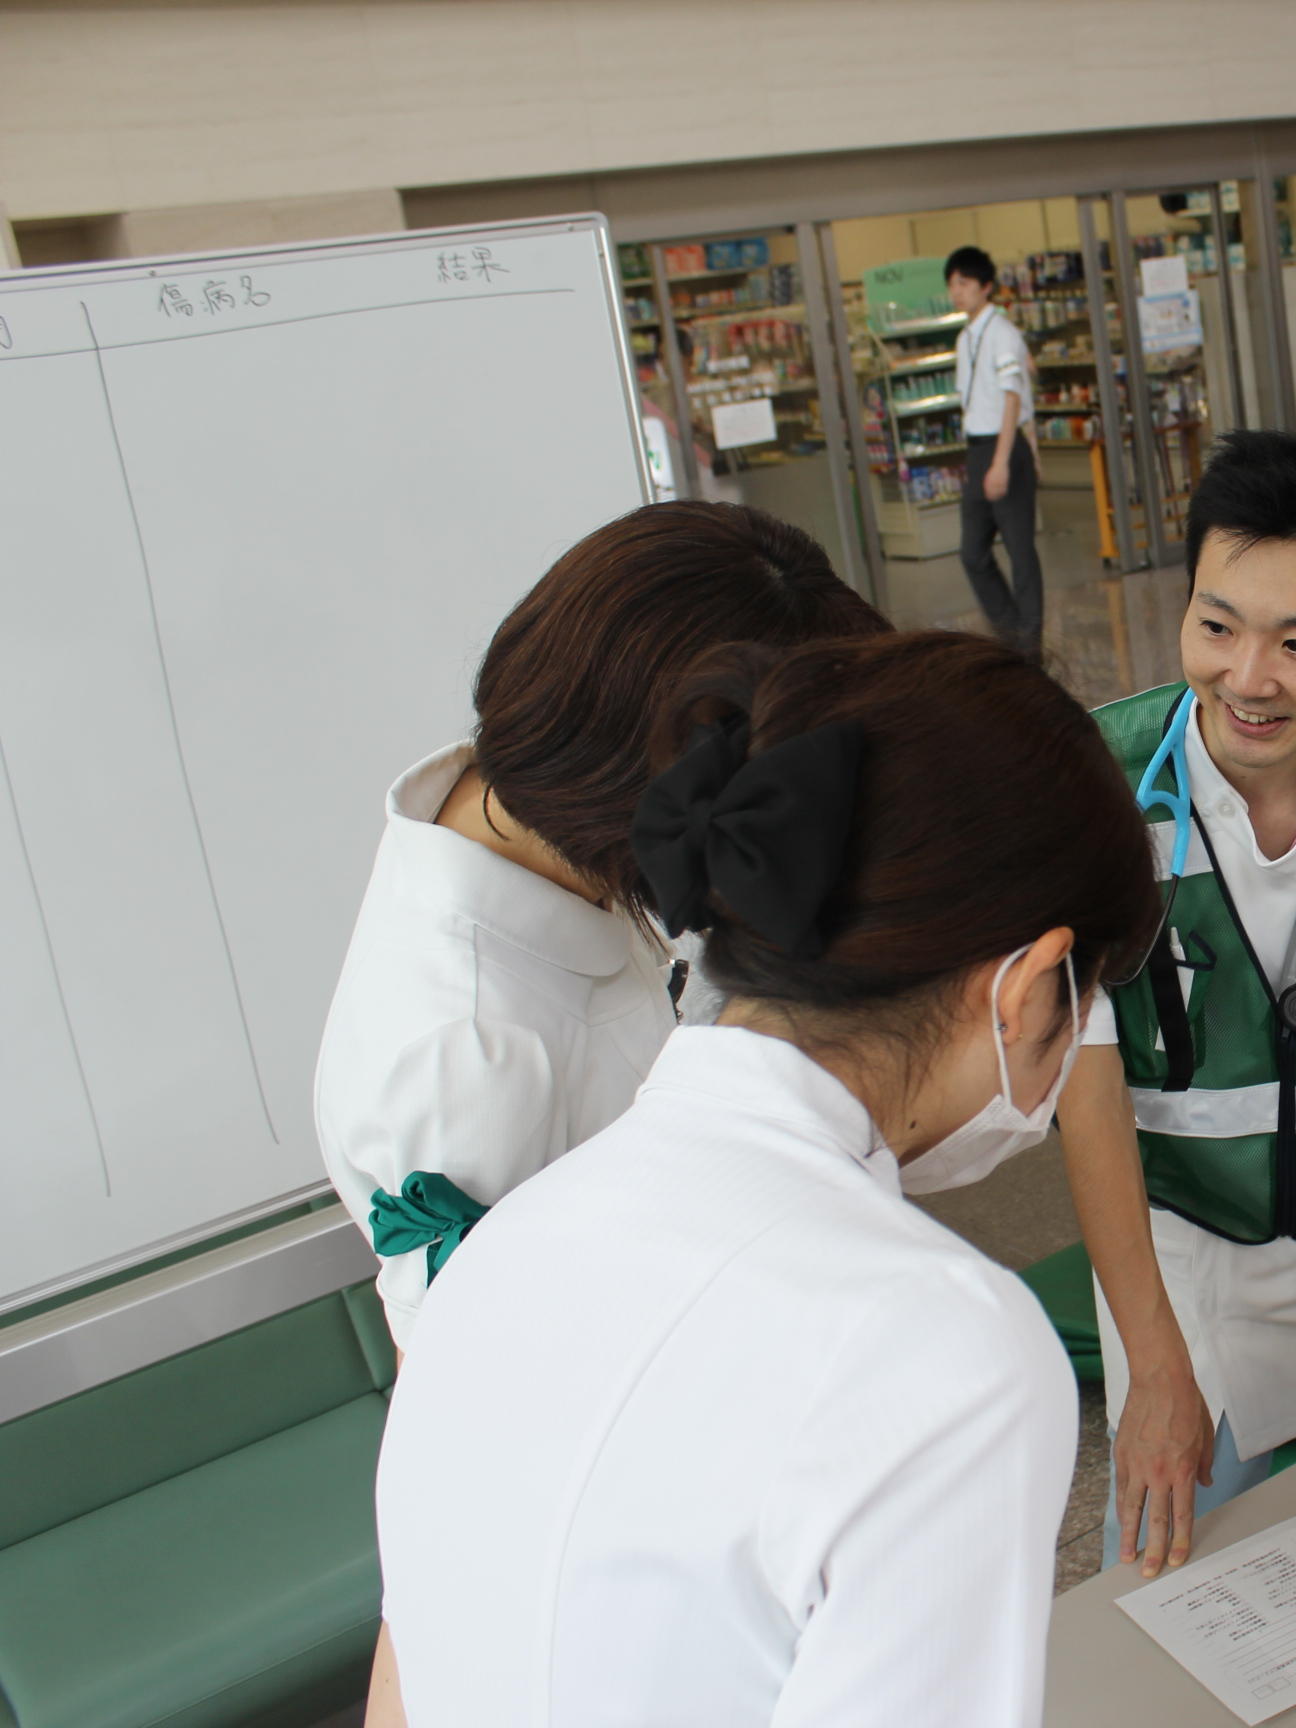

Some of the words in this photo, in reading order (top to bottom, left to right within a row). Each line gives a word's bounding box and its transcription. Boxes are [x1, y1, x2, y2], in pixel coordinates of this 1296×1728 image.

[158, 275, 271, 318] 傷病名
[436, 246, 511, 284] 結果
